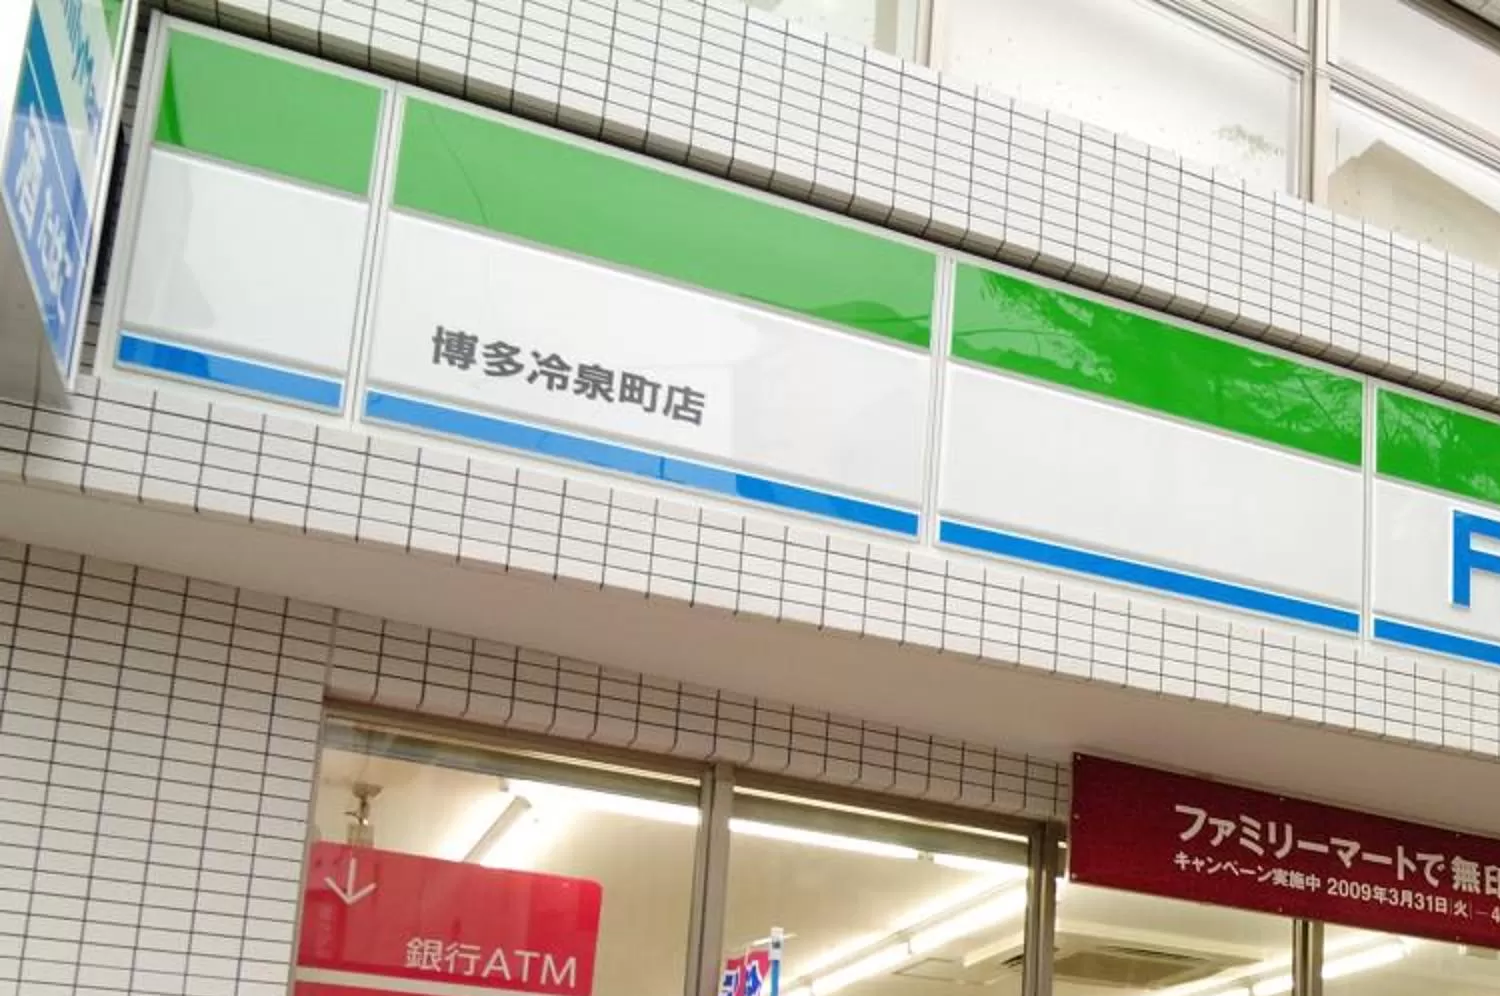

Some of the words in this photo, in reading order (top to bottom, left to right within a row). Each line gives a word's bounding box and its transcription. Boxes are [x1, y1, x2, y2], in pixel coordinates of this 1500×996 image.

[431, 325, 706, 427] 博多冷泉町店
[1173, 851, 1322, 894] キャンペーン実施中
[406, 937, 578, 988] 銀行ATM
